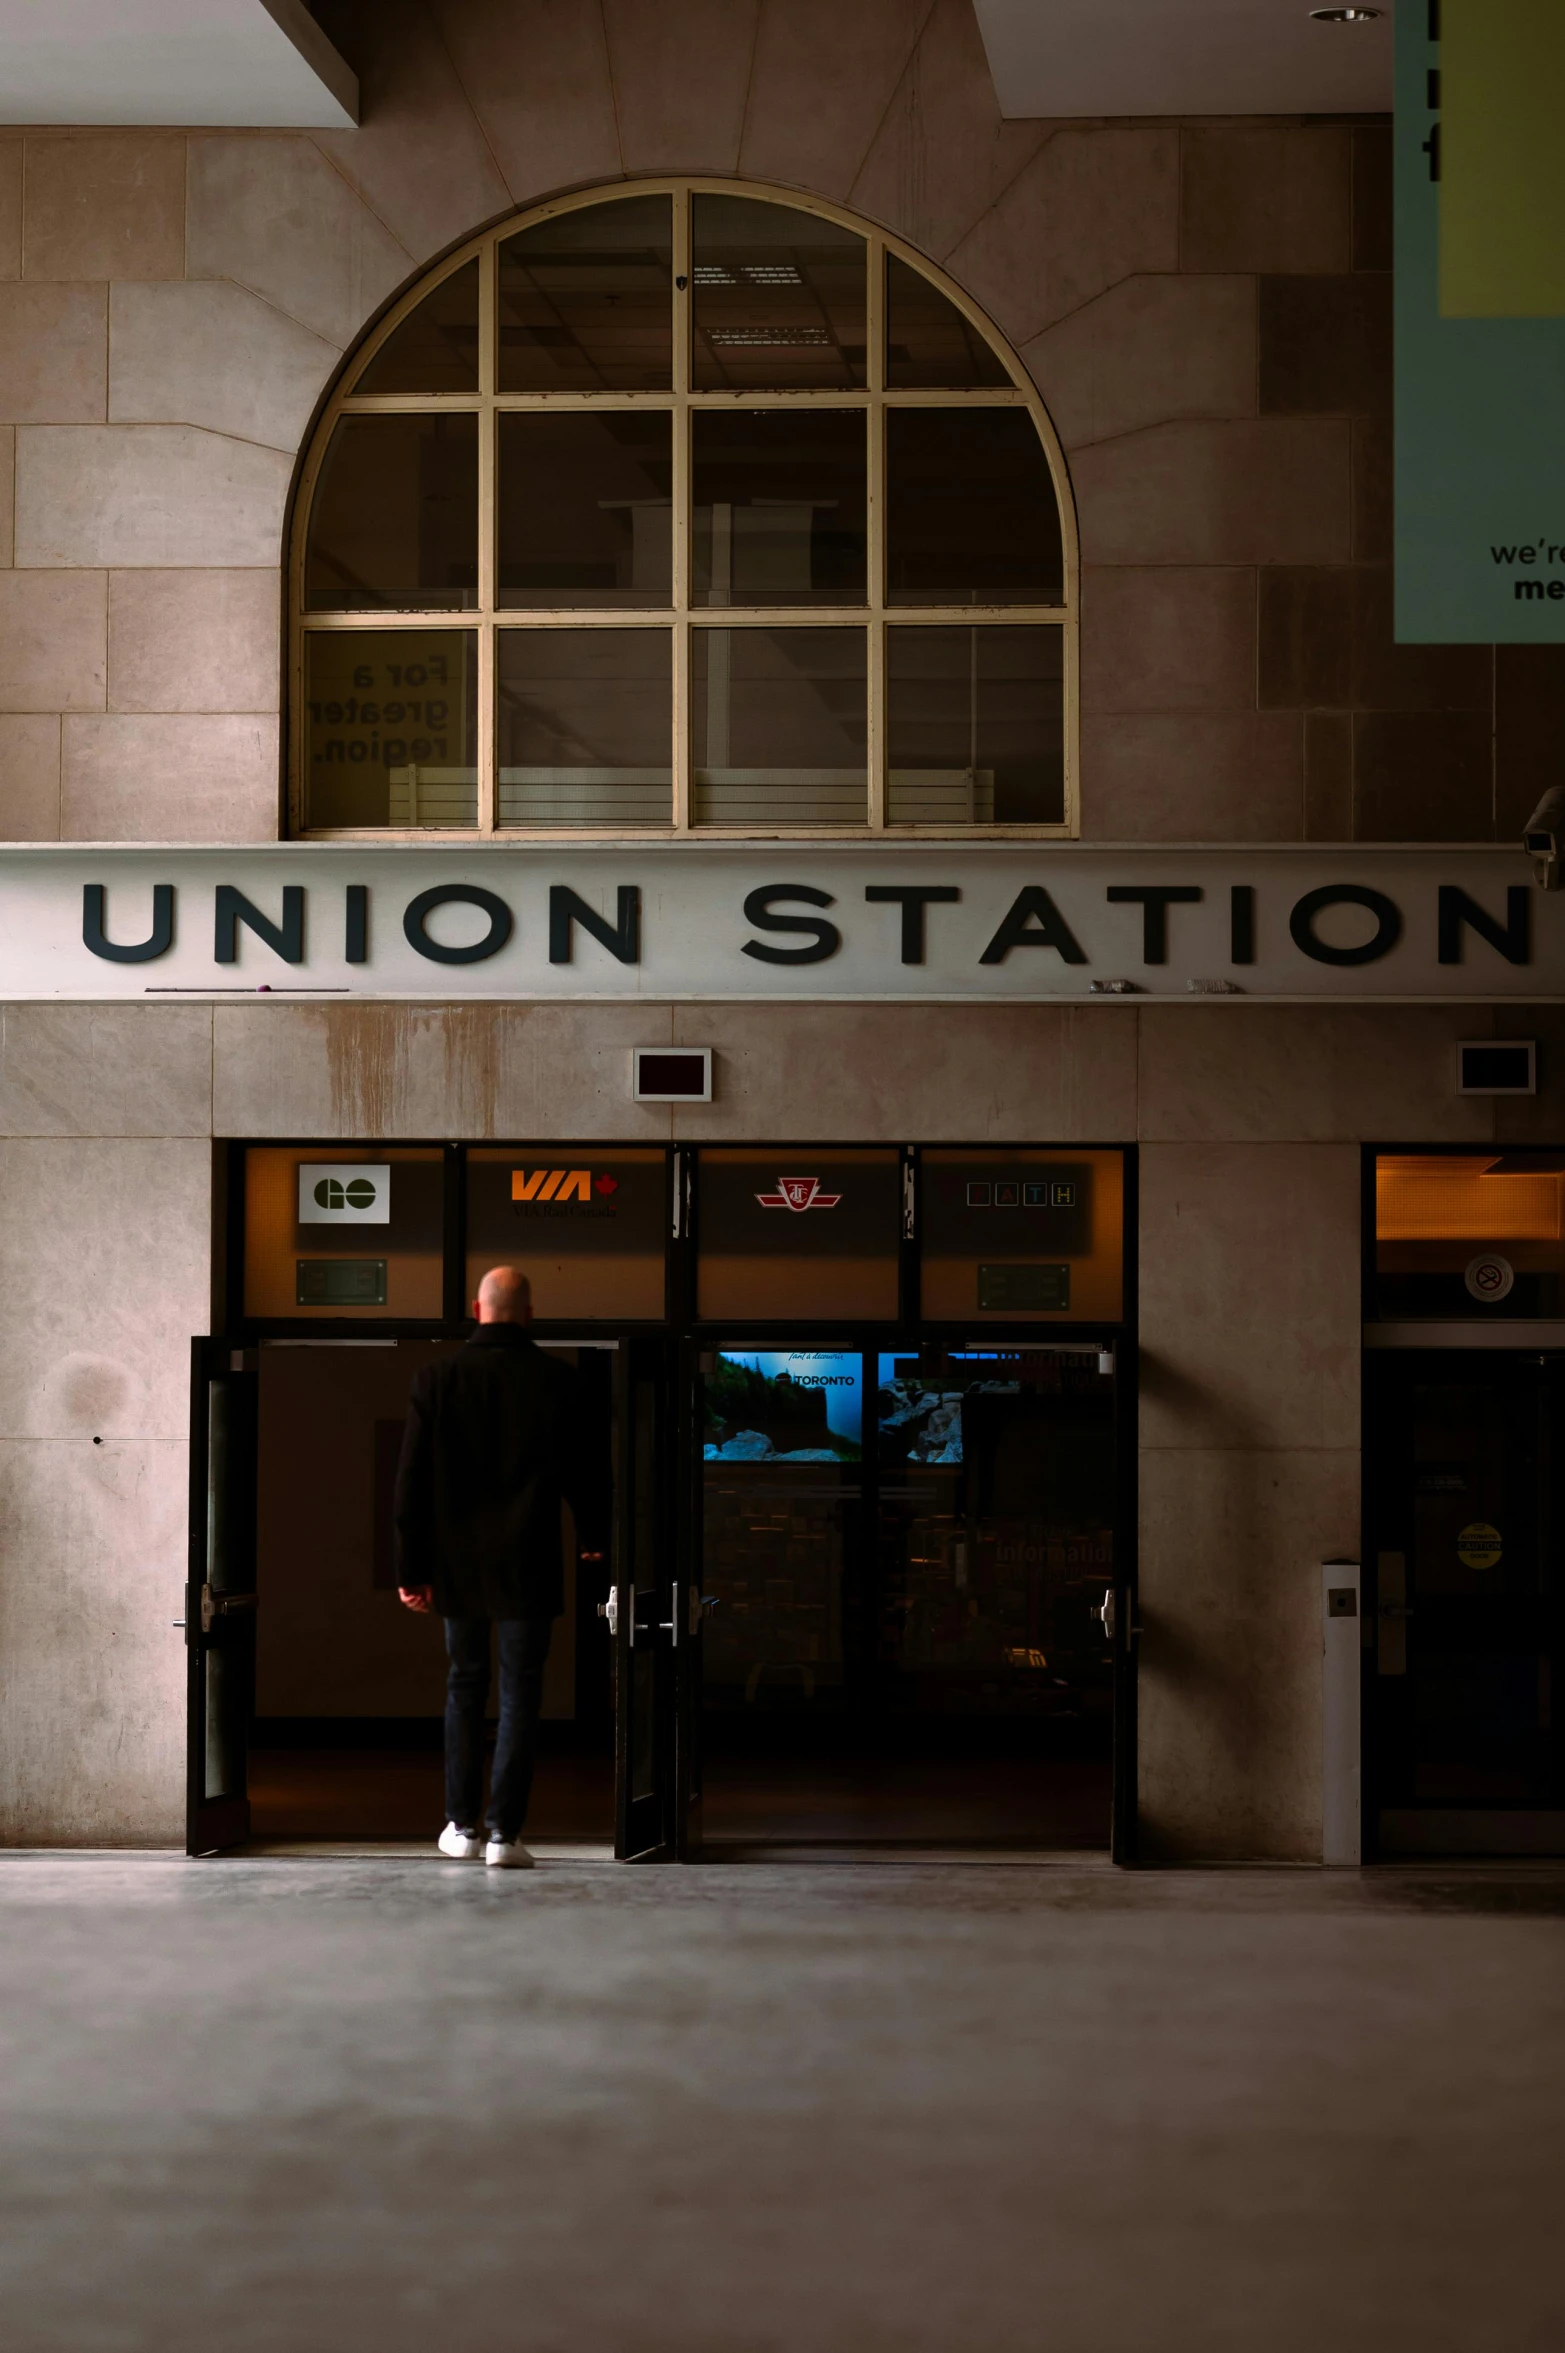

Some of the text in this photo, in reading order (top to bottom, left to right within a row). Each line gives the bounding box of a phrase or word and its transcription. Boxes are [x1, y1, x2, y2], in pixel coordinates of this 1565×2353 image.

[82, 883, 1532, 965] UNION STATION
[314, 1178, 376, 1209] GO
[511, 1170, 591, 1201] VIA
[968, 1184, 1074, 1205] PATH
[512, 1203, 616, 1218] VIA Rail Canada
[795, 1375, 855, 1386] TORONTO
[1457, 1542, 1501, 1550] CAUTION
